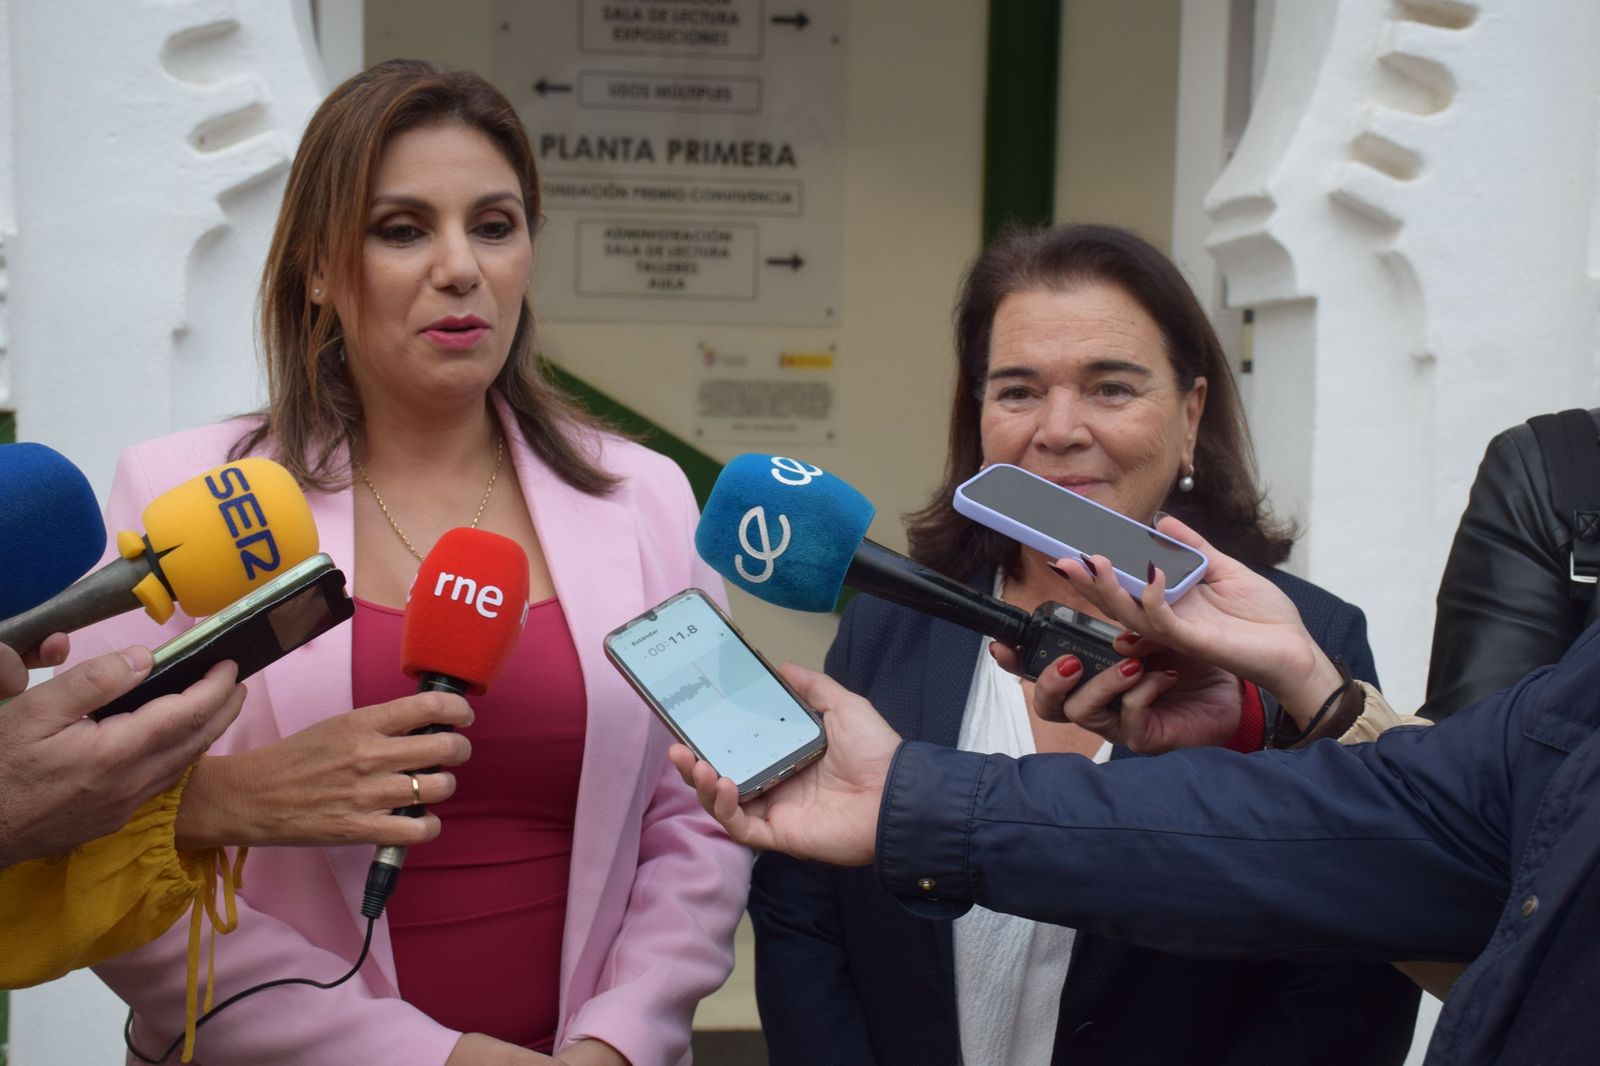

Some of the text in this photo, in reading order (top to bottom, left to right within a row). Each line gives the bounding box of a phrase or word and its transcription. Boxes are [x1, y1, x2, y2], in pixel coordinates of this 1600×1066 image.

[603, 6, 739, 26] SALA DE LECTURA
[612, 26, 729, 46] EXPOSICIONES
[608, 82, 649, 99] USOS
[540, 133, 798, 168] PLANTA PRIMERA
[605, 243, 730, 259] SALA DE LECTURA
[635, 261, 698, 275] TALLERES
[647, 277, 686, 291] AULA
[204, 467, 281, 581] SER
[433, 571, 504, 618] rne
[647, 624, 699, 657] 00:11.8
